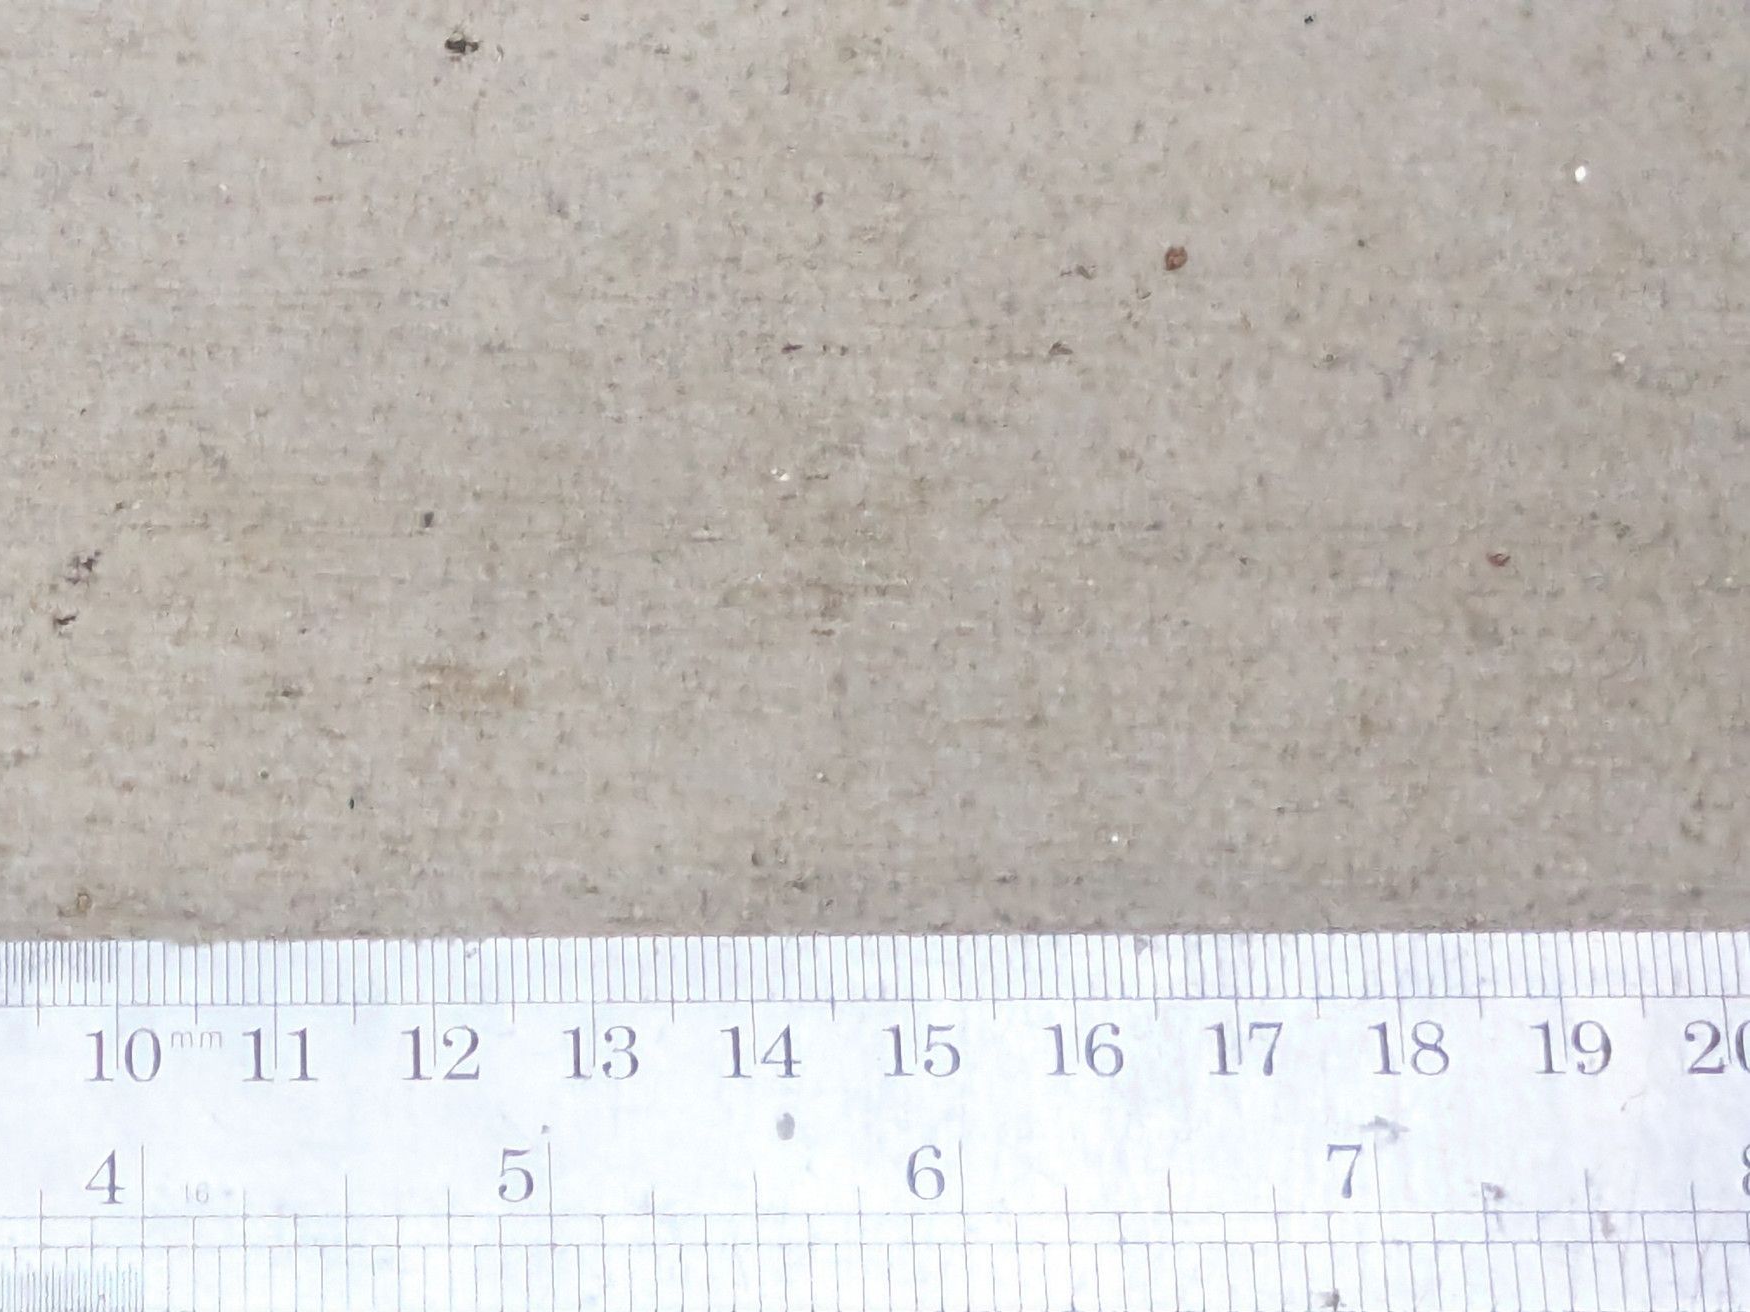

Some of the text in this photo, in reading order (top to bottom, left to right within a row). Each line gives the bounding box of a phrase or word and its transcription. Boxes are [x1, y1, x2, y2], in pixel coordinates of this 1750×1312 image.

[85, 1027, 222, 1082] 10 mm
[243, 1027, 319, 1082] 11
[401, 1025, 482, 1081] 12
[563, 1025, 639, 1081] 13
[720, 1024, 802, 1078] 14
[882, 1023, 961, 1078] 15
[1044, 1022, 1124, 1077] 16
[1205, 1021, 1284, 1076] 17
[1367, 1020, 1450, 1076] 18
[1530, 1020, 1613, 1075] 19
[85, 1149, 125, 1204] 4
[499, 1148, 534, 1203] 5
[906, 1145, 945, 1200] 6
[1326, 1144, 1363, 1198] 7
